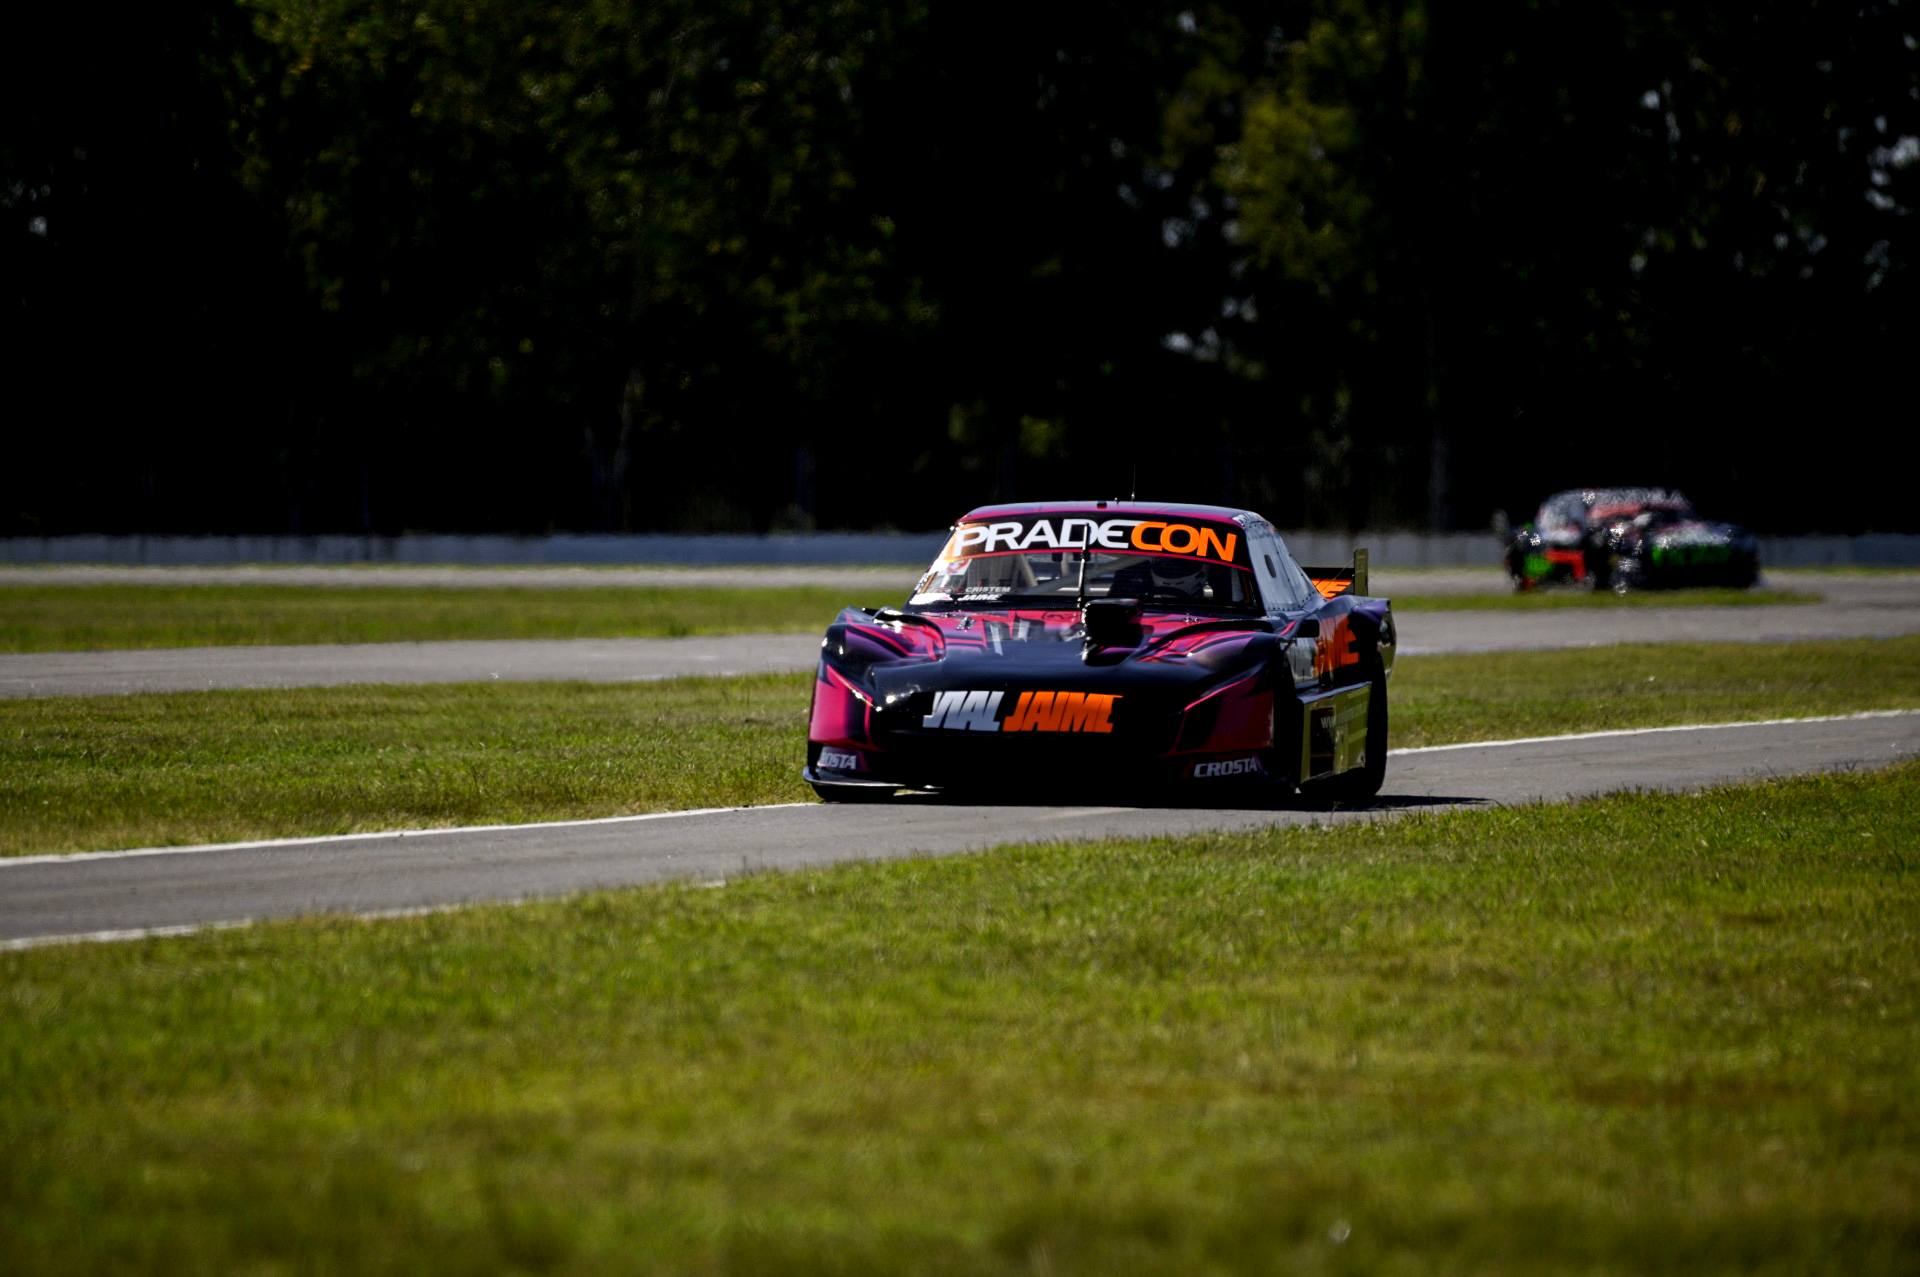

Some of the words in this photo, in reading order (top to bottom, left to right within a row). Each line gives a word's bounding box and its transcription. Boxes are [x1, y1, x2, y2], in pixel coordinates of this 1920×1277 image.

[954, 518, 1238, 562] PRADECON
[1003, 691, 1123, 733] JAIME
[1194, 757, 1258, 778] CROSTA
